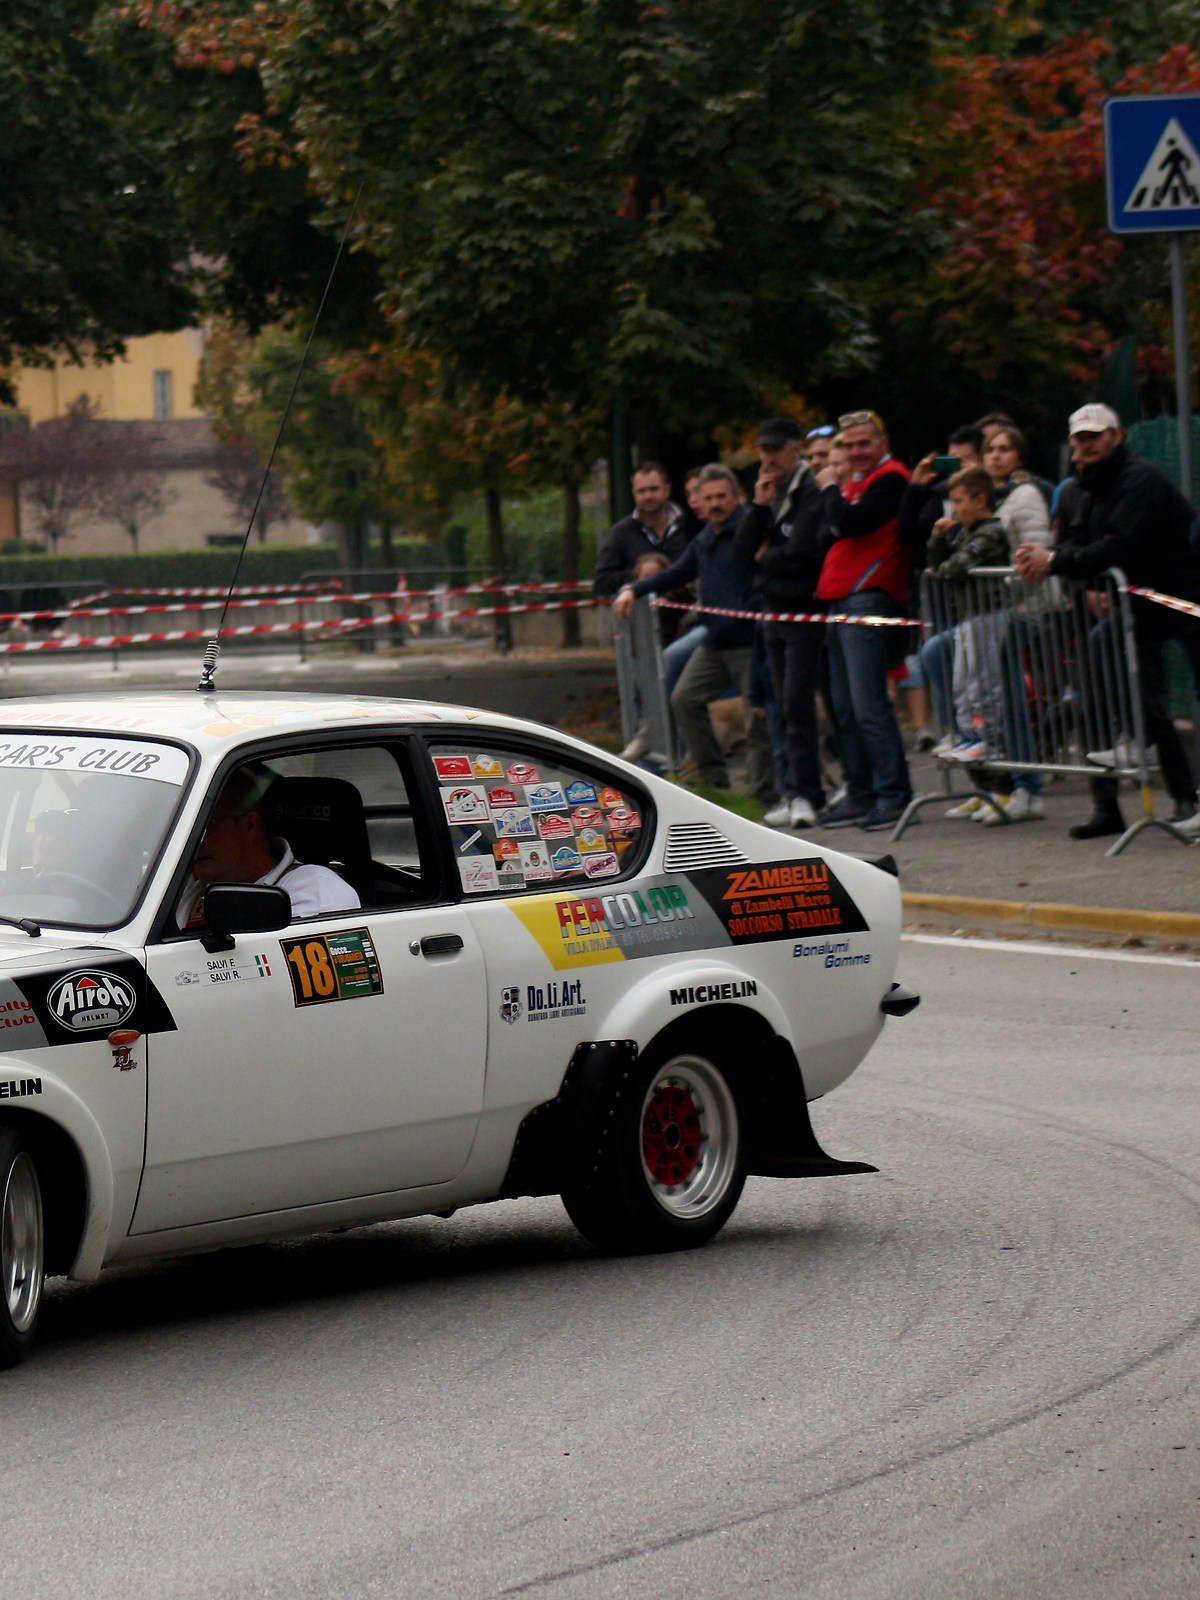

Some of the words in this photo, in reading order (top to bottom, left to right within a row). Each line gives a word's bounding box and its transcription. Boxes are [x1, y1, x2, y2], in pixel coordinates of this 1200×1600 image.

[78, 748, 161, 774] CLUB
[722, 864, 829, 900] ZAMBELLI
[555, 884, 696, 939] FERCOLOR
[743, 895, 793, 914] Zambelli
[794, 894, 831, 907] Marco
[728, 914, 784, 936] SOCCORSO
[787, 907, 843, 930] STRADALE
[793, 939, 851, 959] Bonalumi
[824, 952, 871, 969] Gomme
[207, 960, 228, 971] SALVI
[210, 972, 232, 983] SALVI
[233, 970, 242, 980] R.
[287, 941, 336, 998] 18
[56, 977, 131, 1017] Airoh
[669, 980, 758, 1006] MICHELIN
[81, 1012, 109, 1022] HELMET
